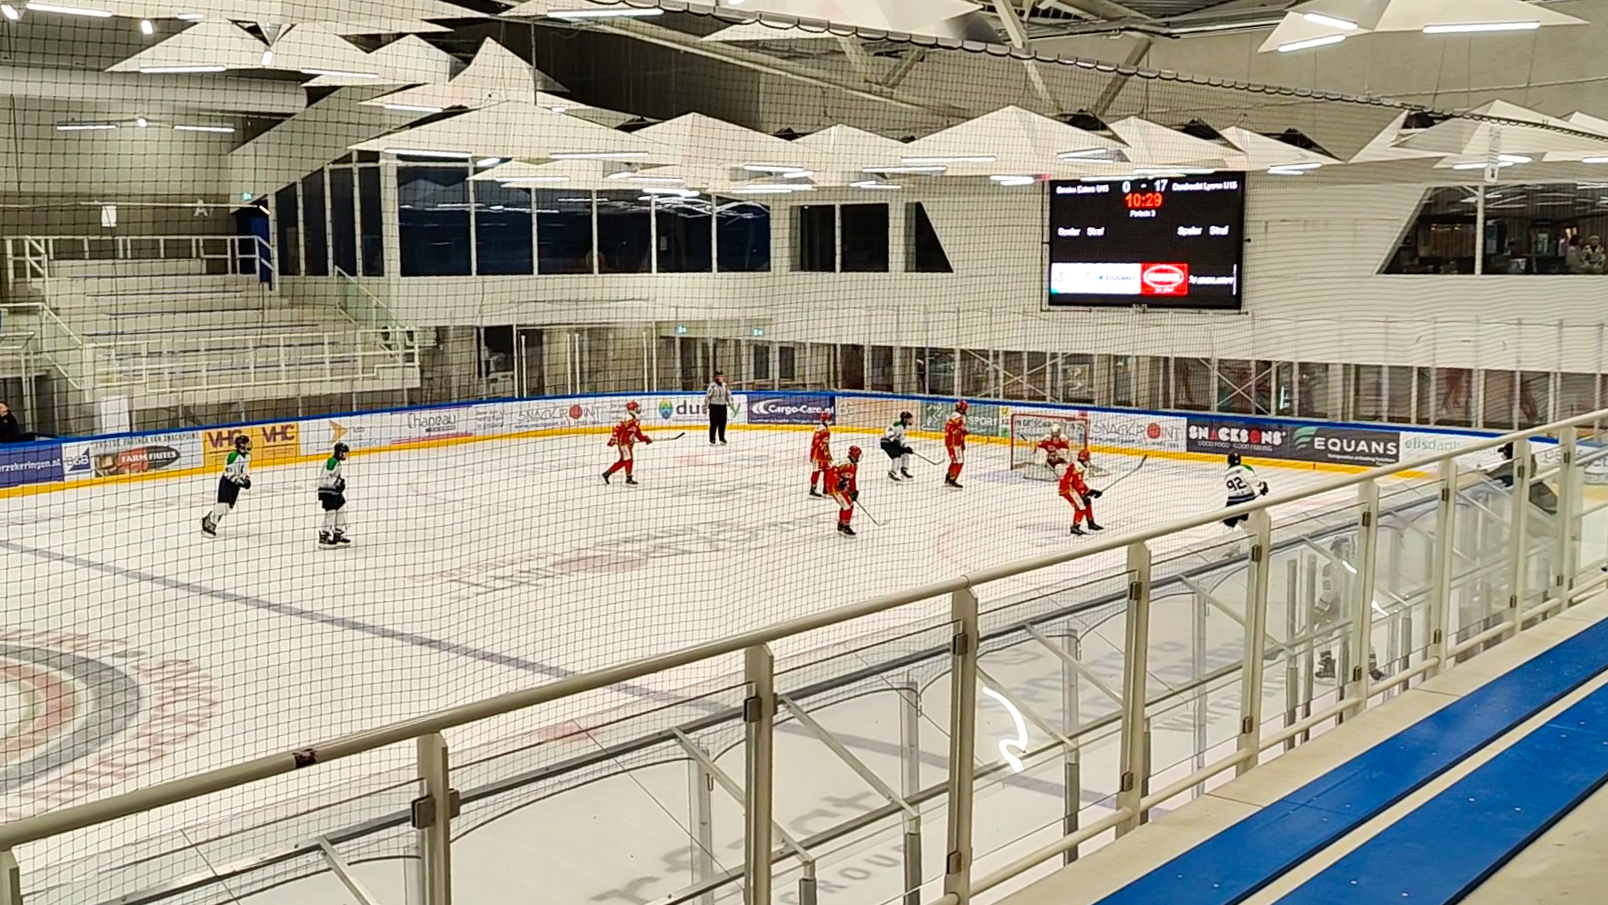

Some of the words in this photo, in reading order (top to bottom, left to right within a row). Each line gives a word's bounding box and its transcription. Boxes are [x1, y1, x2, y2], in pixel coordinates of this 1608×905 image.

[1122, 180, 1131, 193] 0
[1154, 179, 1168, 192] 17
[1125, 192, 1162, 208] 10:29
[262, 424, 295, 442] VHC
[1314, 437, 1397, 455] EQUANS
[121, 453, 147, 463] FARM
[148, 451, 177, 461] FRITES
[0, 458, 61, 472] rzekeringen.nl
[1226, 477, 1247, 491] 92
